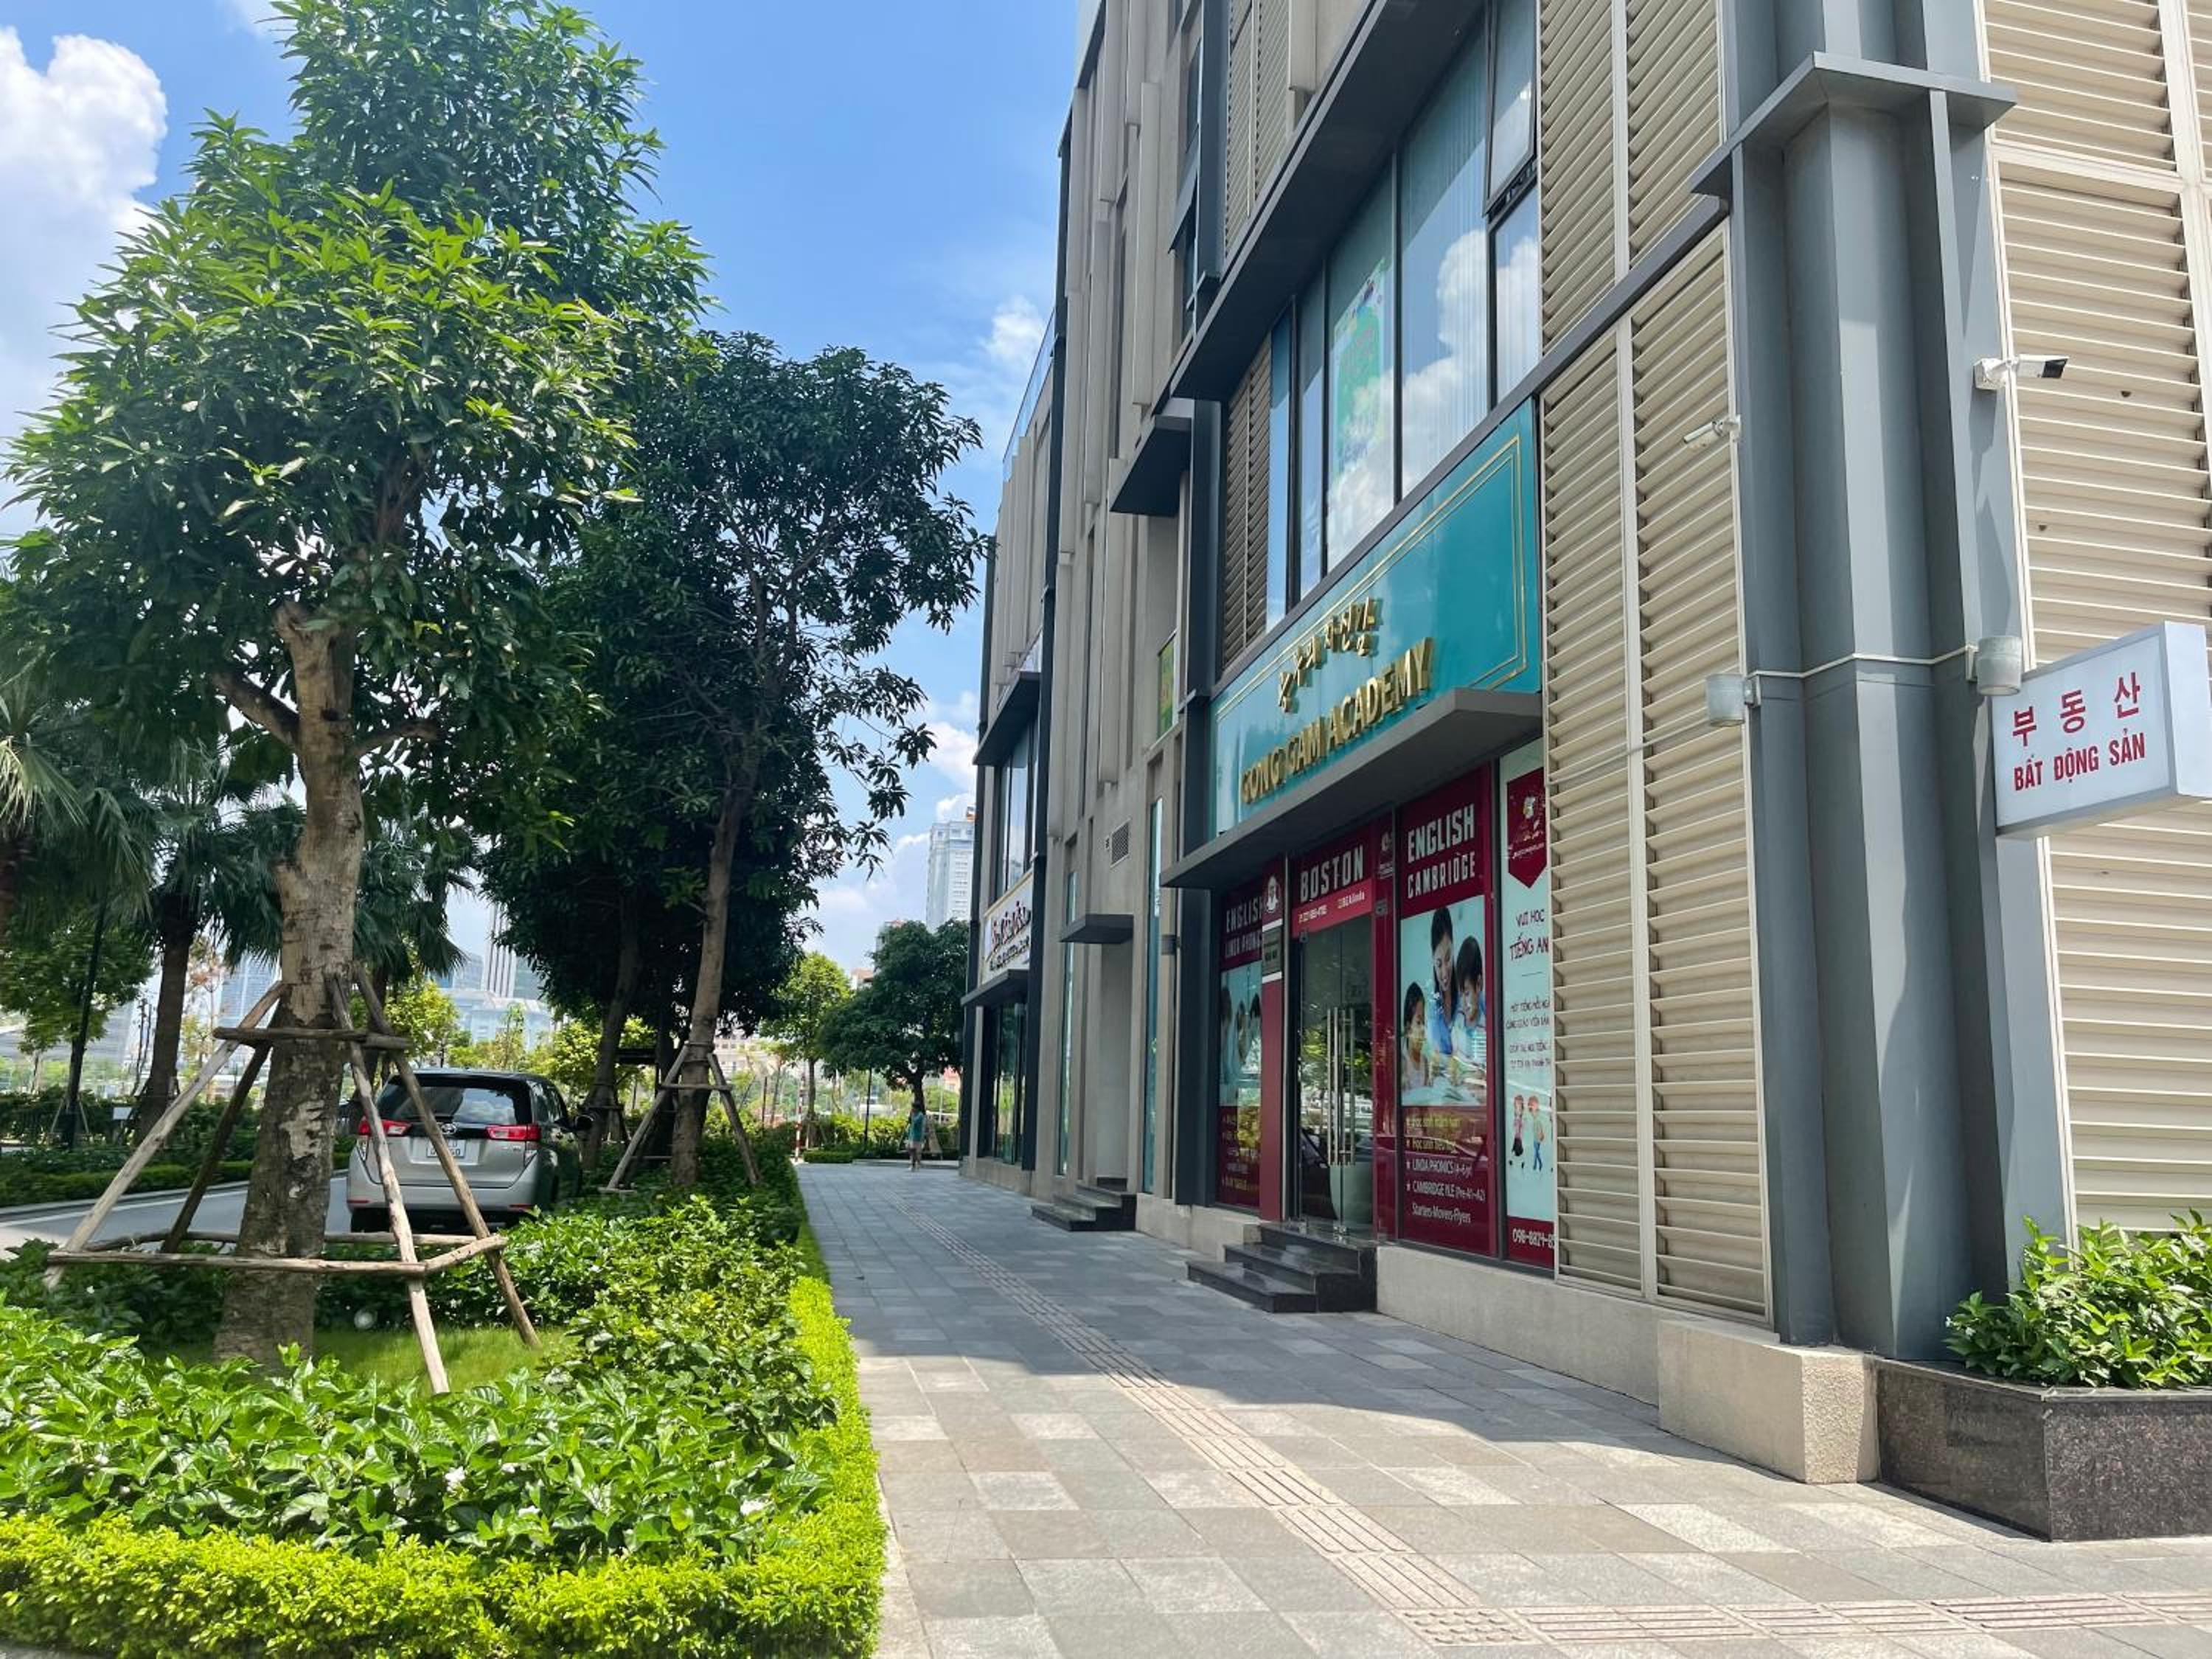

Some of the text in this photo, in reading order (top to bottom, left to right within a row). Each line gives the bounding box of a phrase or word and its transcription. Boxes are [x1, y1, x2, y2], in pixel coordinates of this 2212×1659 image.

[1240, 746, 1286, 805] GONG
[1328, 636, 1433, 751] ACADEMY
[2012, 671, 2141, 748] 부동산
[2013, 727, 2146, 792] BẤT ĐỘNG SẢN
[1407, 803, 1475, 864] ENGLISH
[1300, 844, 1364, 904] BOSTON
[1407, 851, 1475, 899] CAMBRIDGE
[1413, 1180, 1444, 1197] CAMBRIDGE
